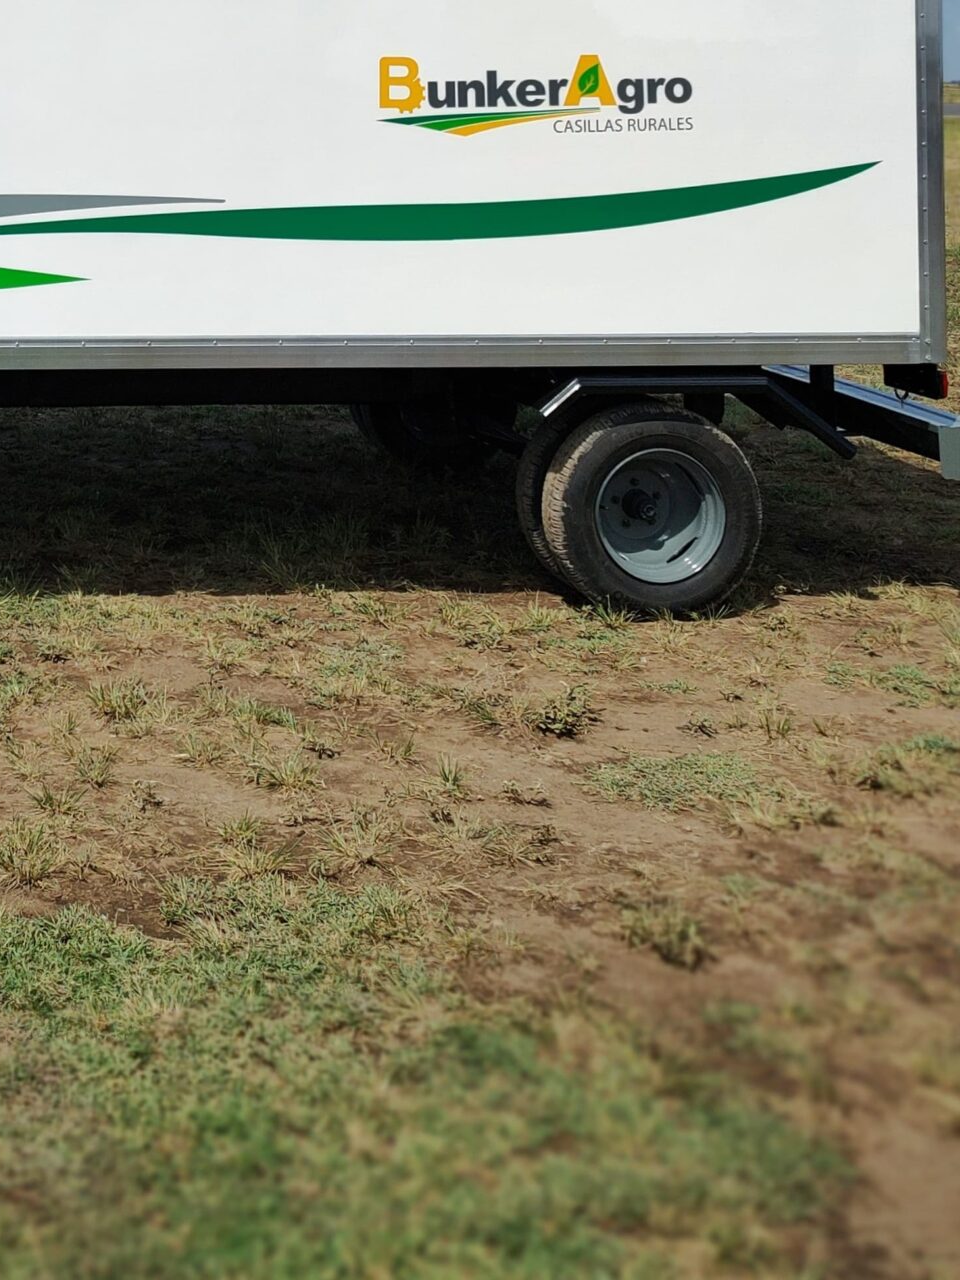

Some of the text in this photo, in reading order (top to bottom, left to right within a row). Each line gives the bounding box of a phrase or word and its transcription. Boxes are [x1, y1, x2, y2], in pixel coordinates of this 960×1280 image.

[378, 54, 693, 114] BunkerAgro
[553, 117, 694, 134] CASILLAS RURALES
